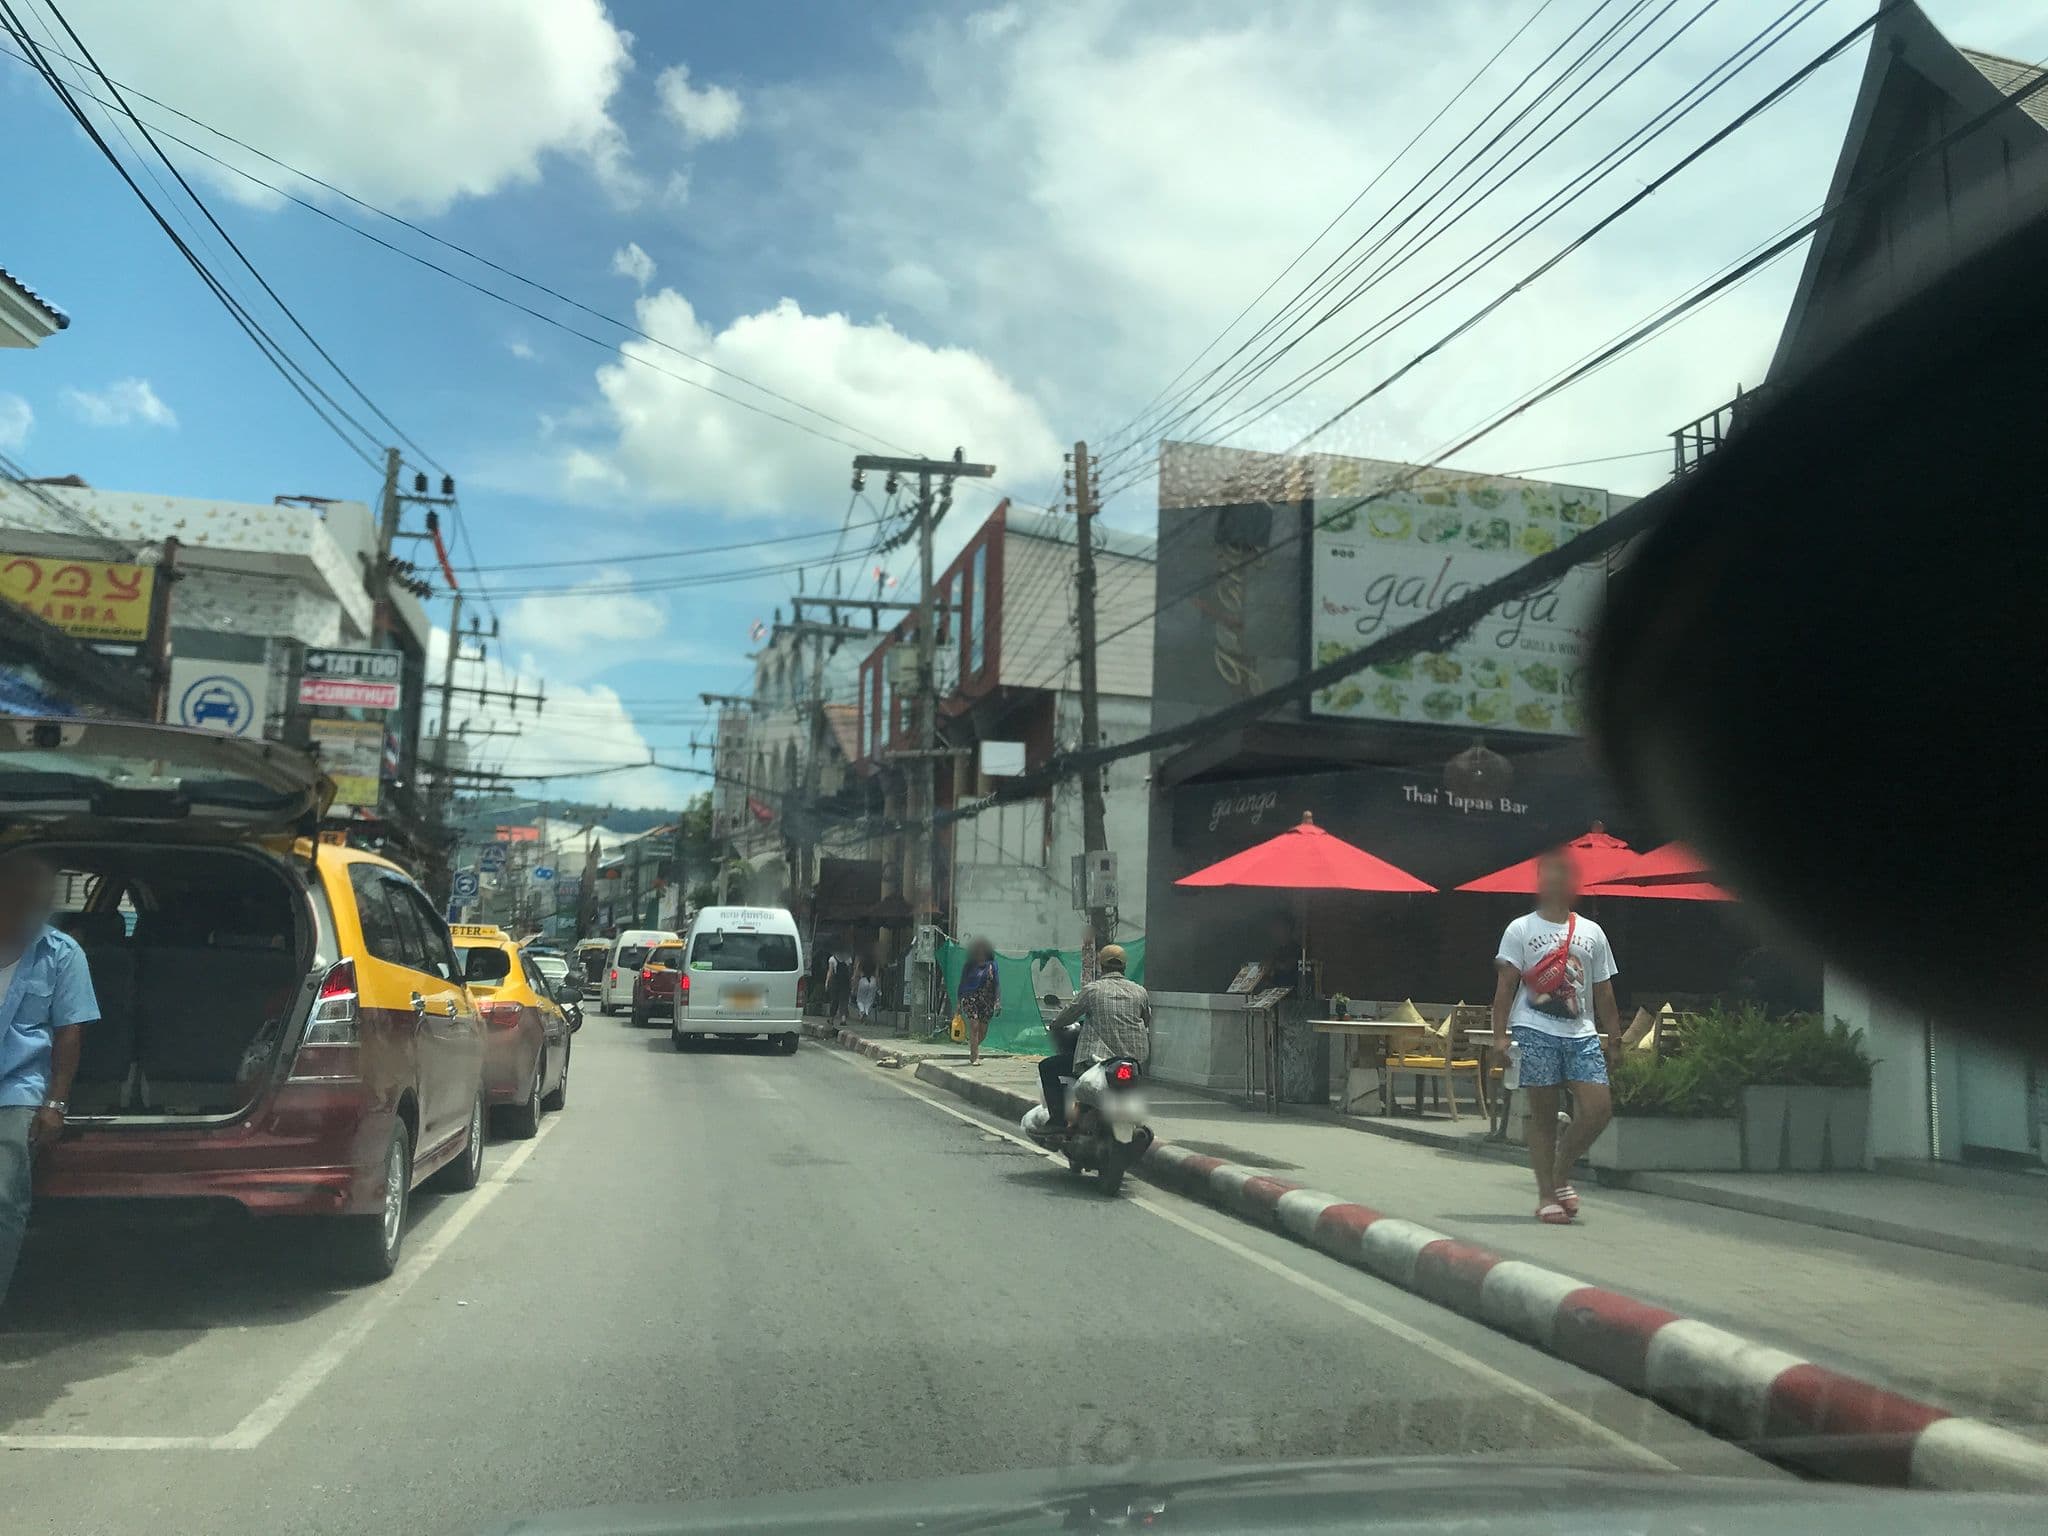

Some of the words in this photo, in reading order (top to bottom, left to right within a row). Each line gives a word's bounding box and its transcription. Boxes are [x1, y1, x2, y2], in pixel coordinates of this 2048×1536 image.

[1356, 556, 1562, 649] galaga
[326, 653, 398, 676] TATTOO
[1403, 785, 1438, 805] Thai
[1446, 790, 1494, 814] Tapas
[1500, 798, 1528, 816] Bar
[449, 926, 482, 936] ETER
